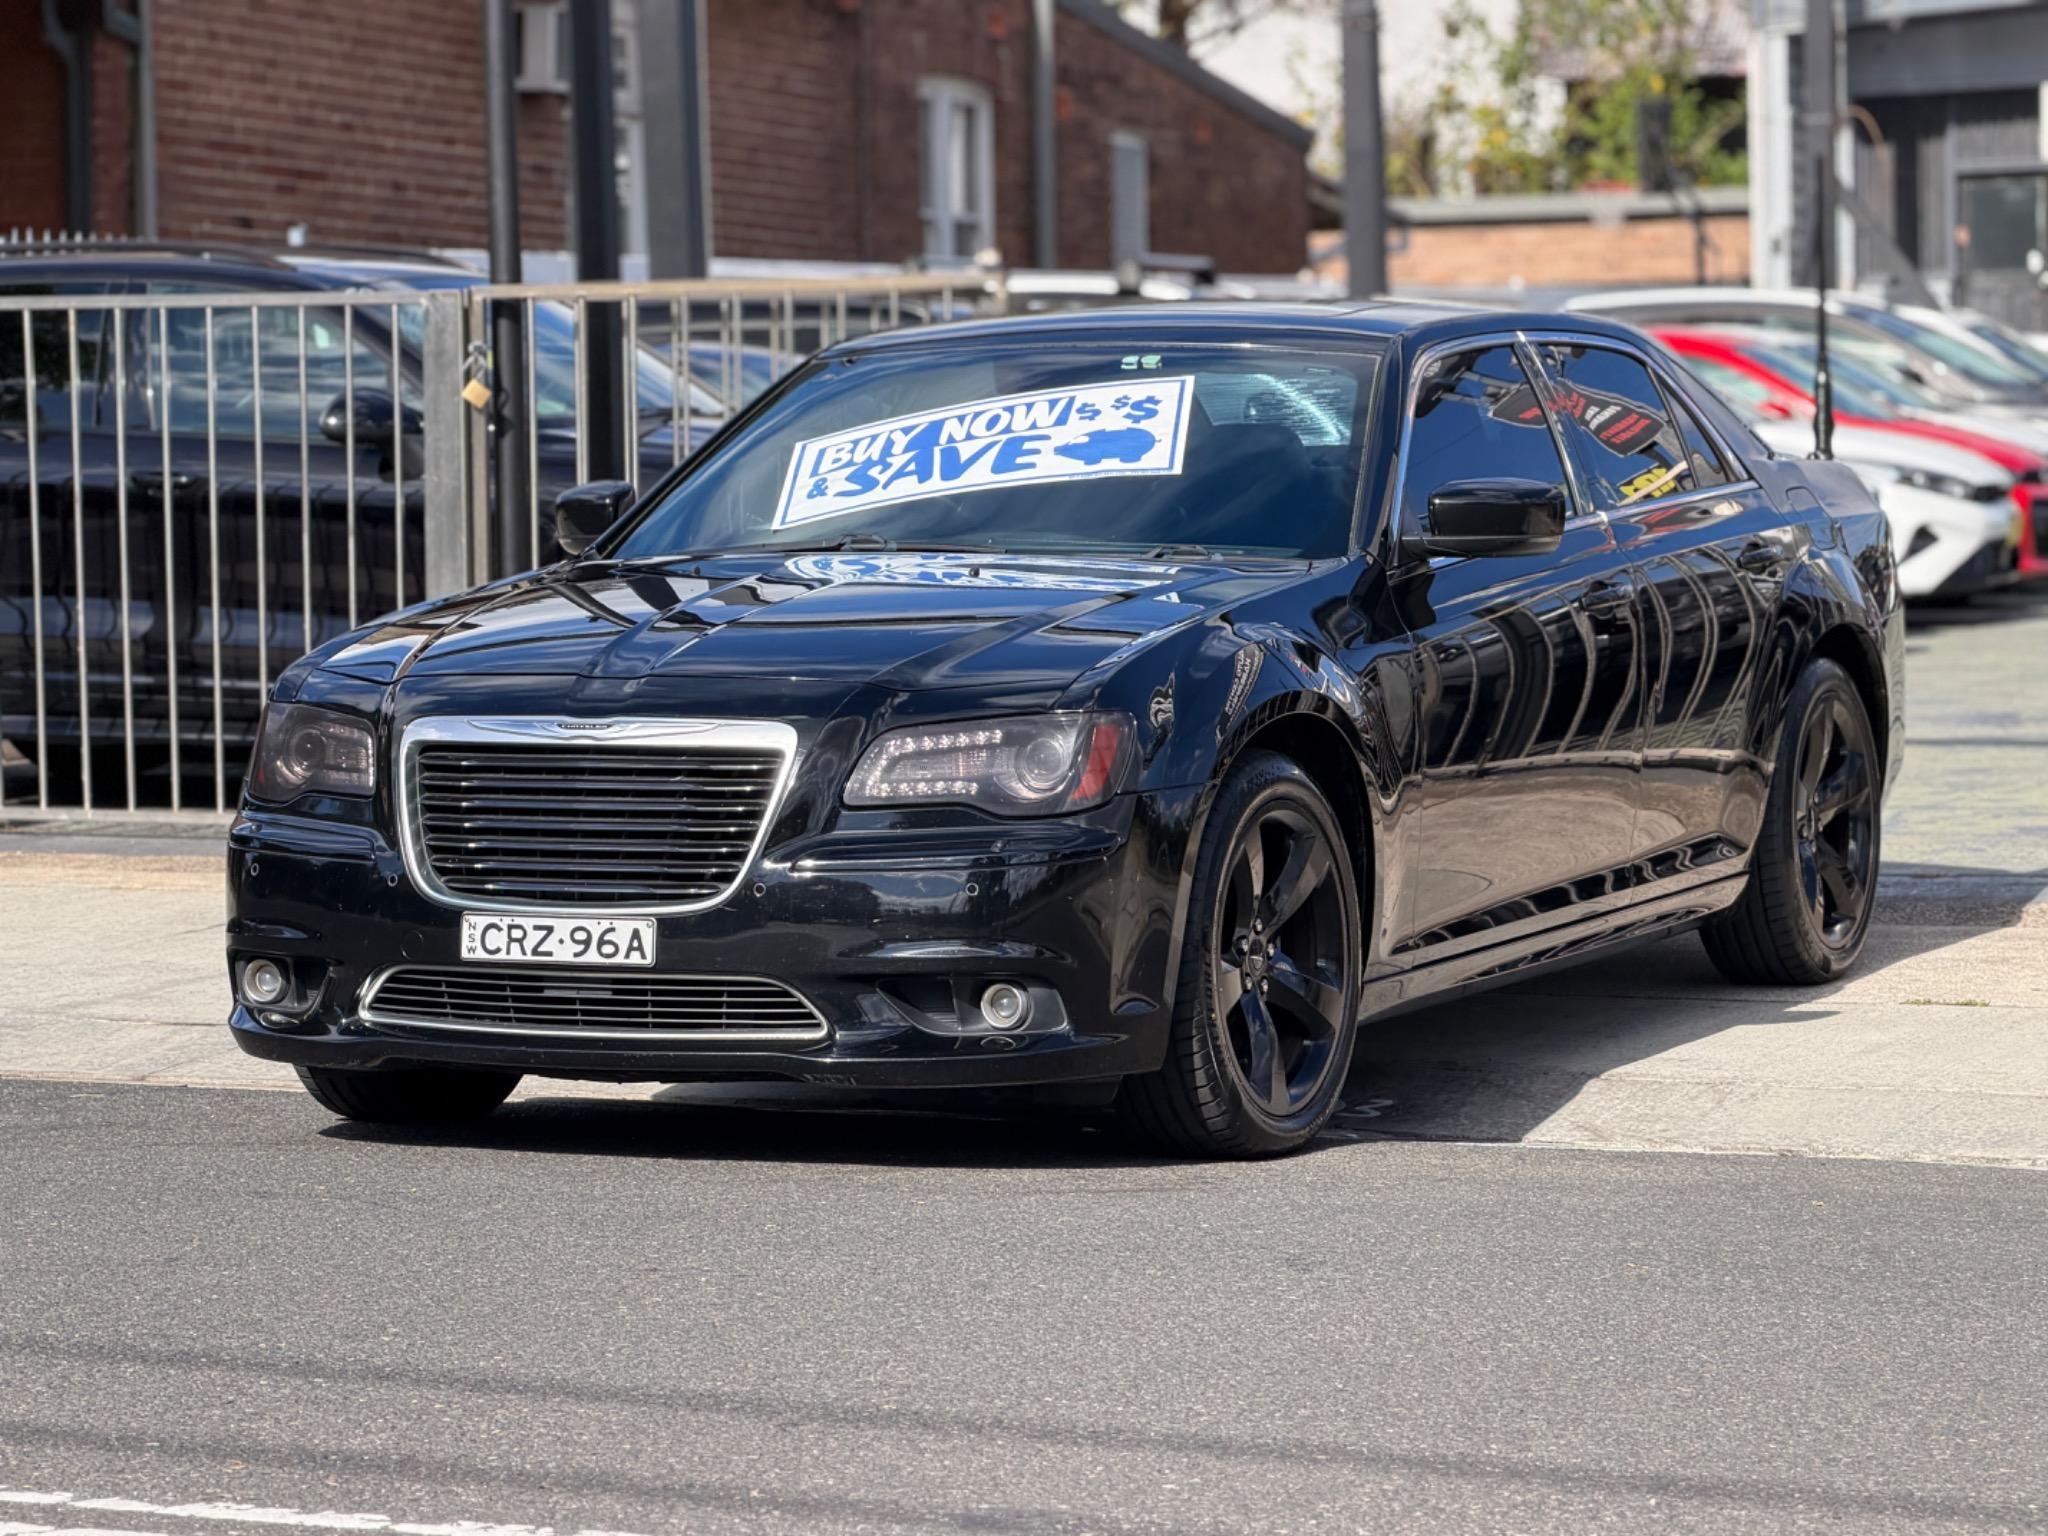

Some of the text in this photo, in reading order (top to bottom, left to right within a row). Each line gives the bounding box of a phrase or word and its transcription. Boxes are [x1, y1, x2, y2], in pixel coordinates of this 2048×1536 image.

[806, 434, 1051, 500] & SAVE
[818, 423, 930, 474] BUY
[939, 398, 1071, 445] NOW
